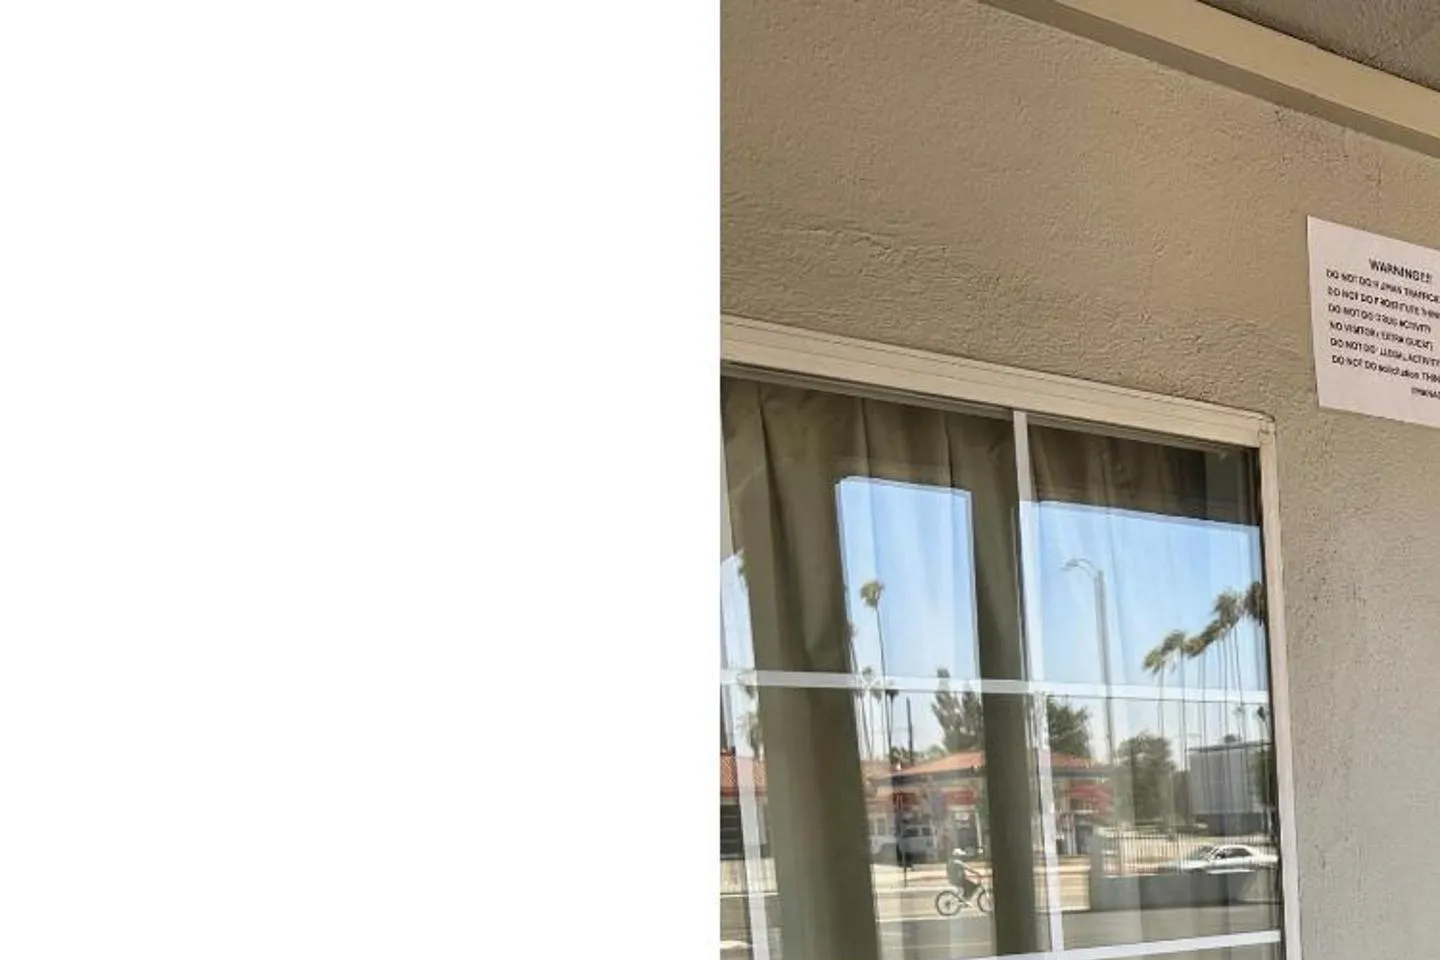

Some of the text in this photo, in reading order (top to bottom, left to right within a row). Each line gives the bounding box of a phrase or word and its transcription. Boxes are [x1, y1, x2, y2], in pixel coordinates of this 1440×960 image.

[1326, 269, 1339, 280] DO
[1341, 272, 1357, 284] NOT
[1359, 276, 1371, 287] DO
[1327, 286, 1341, 297] DO
[1342, 289, 1358, 300] NOT
[1360, 293, 1373, 304] DO
[1328, 303, 1341, 314] DO
[1343, 306, 1360, 317] NOT
[1361, 310, 1373, 321] DO
[1329, 320, 1343, 331] NO
[1330, 337, 1344, 348] DO
[1345, 340, 1362, 352] NOT
[1363, 343, 1375, 354] DO
[1332, 354, 1344, 366] DO
[1346, 356, 1362, 368] NOT
[1364, 360, 1377, 371] DO
